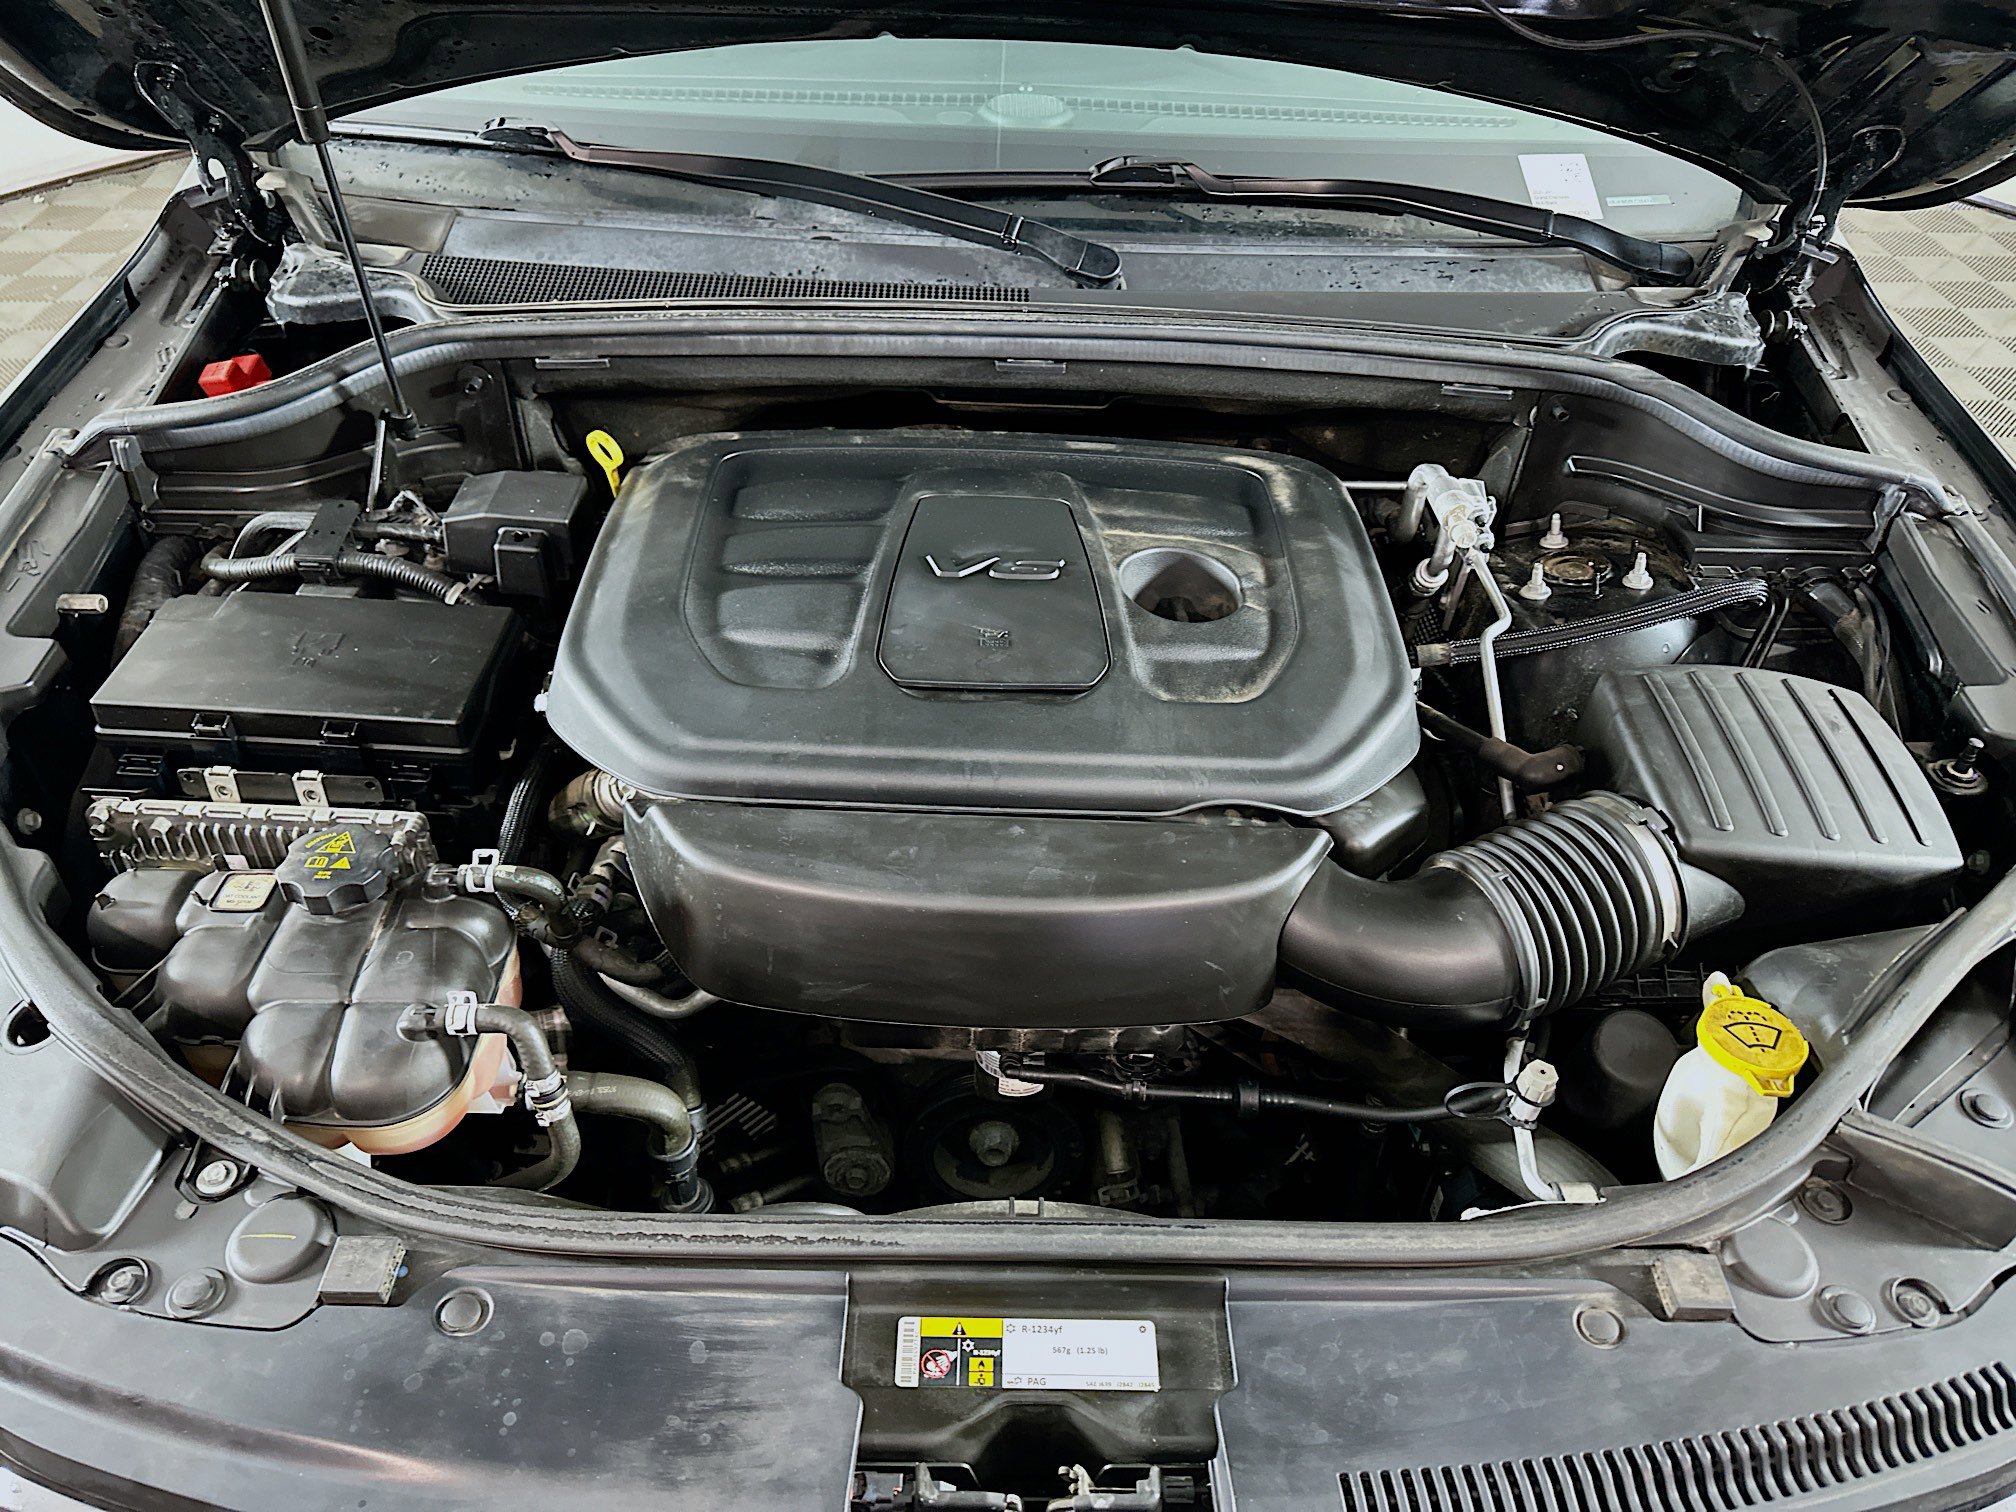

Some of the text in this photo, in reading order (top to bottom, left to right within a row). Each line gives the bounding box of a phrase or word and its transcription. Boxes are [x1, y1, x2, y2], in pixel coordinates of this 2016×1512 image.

[1021, 1325, 1063, 1335] R-1234yf
[1052, 1346, 1109, 1356] 567g (1.25 lb)
[1027, 1377, 1046, 1386] PAG
